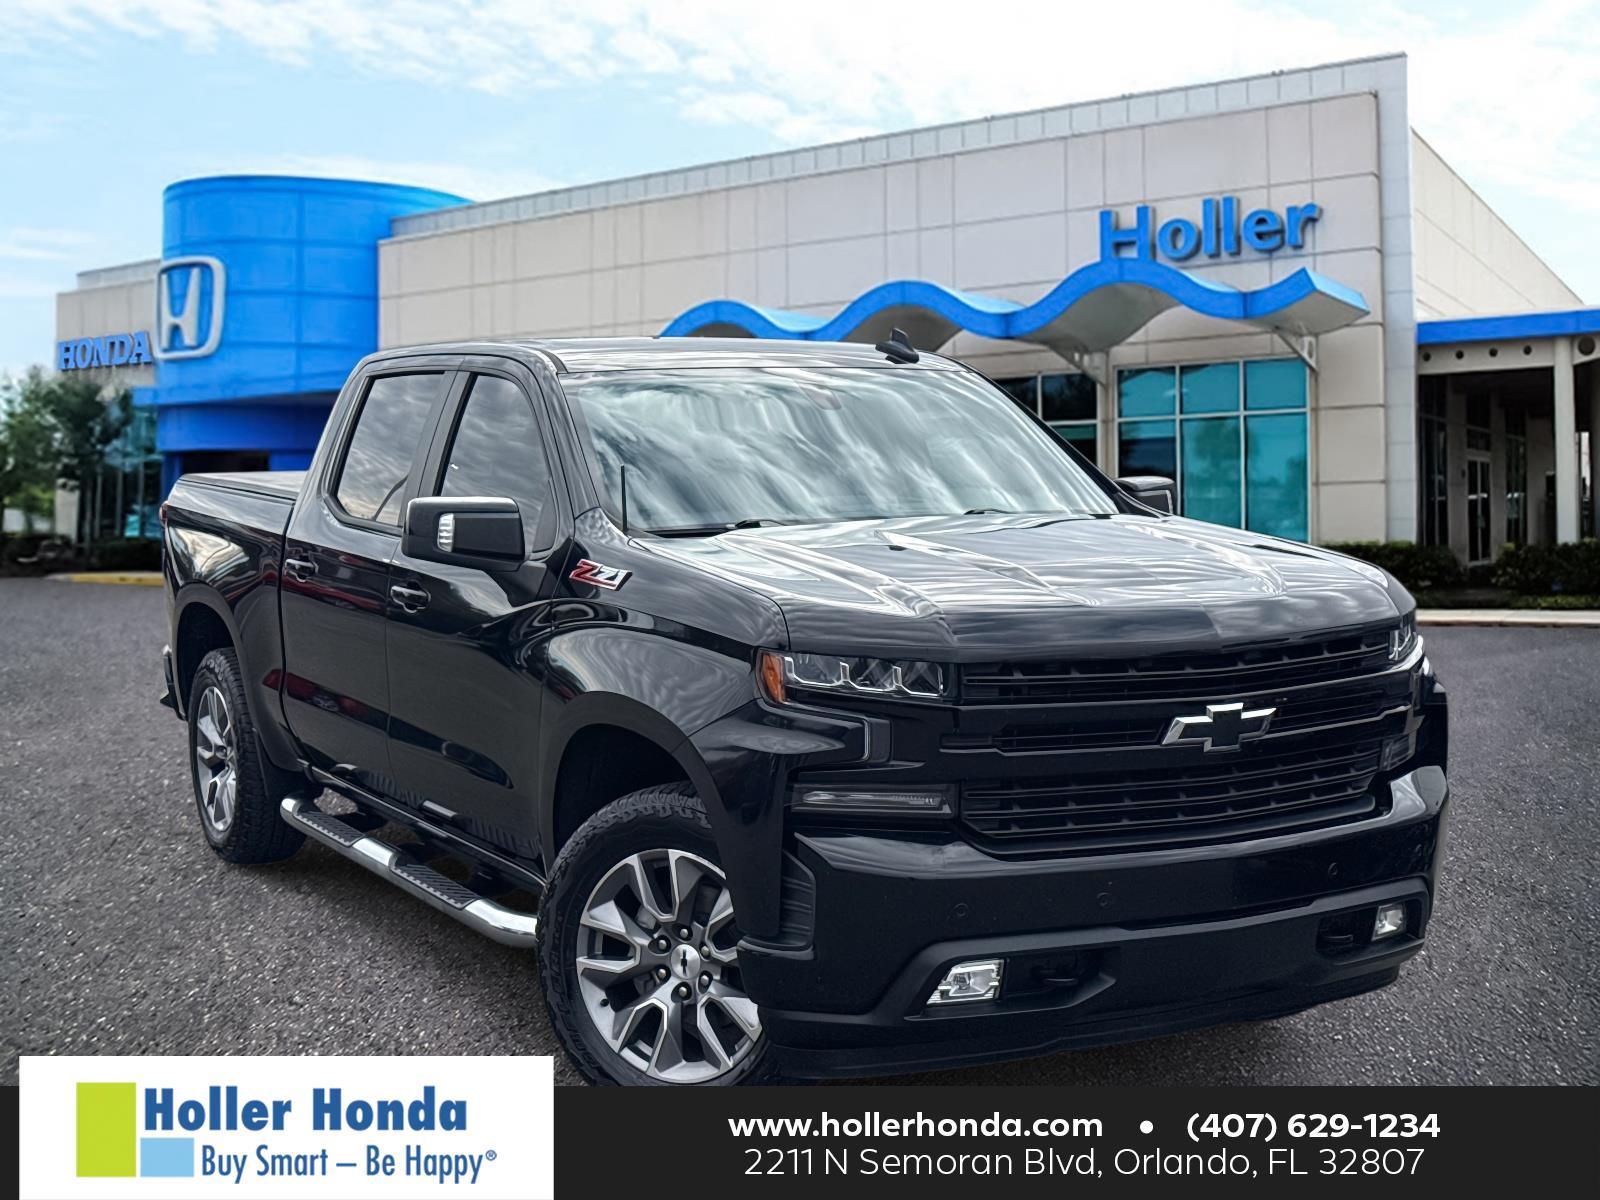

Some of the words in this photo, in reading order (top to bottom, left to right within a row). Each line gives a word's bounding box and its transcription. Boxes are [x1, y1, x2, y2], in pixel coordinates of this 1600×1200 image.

[1099, 195, 1321, 262] Holler
[57, 330, 153, 371] HONDA
[569, 558, 632, 591] Z71
